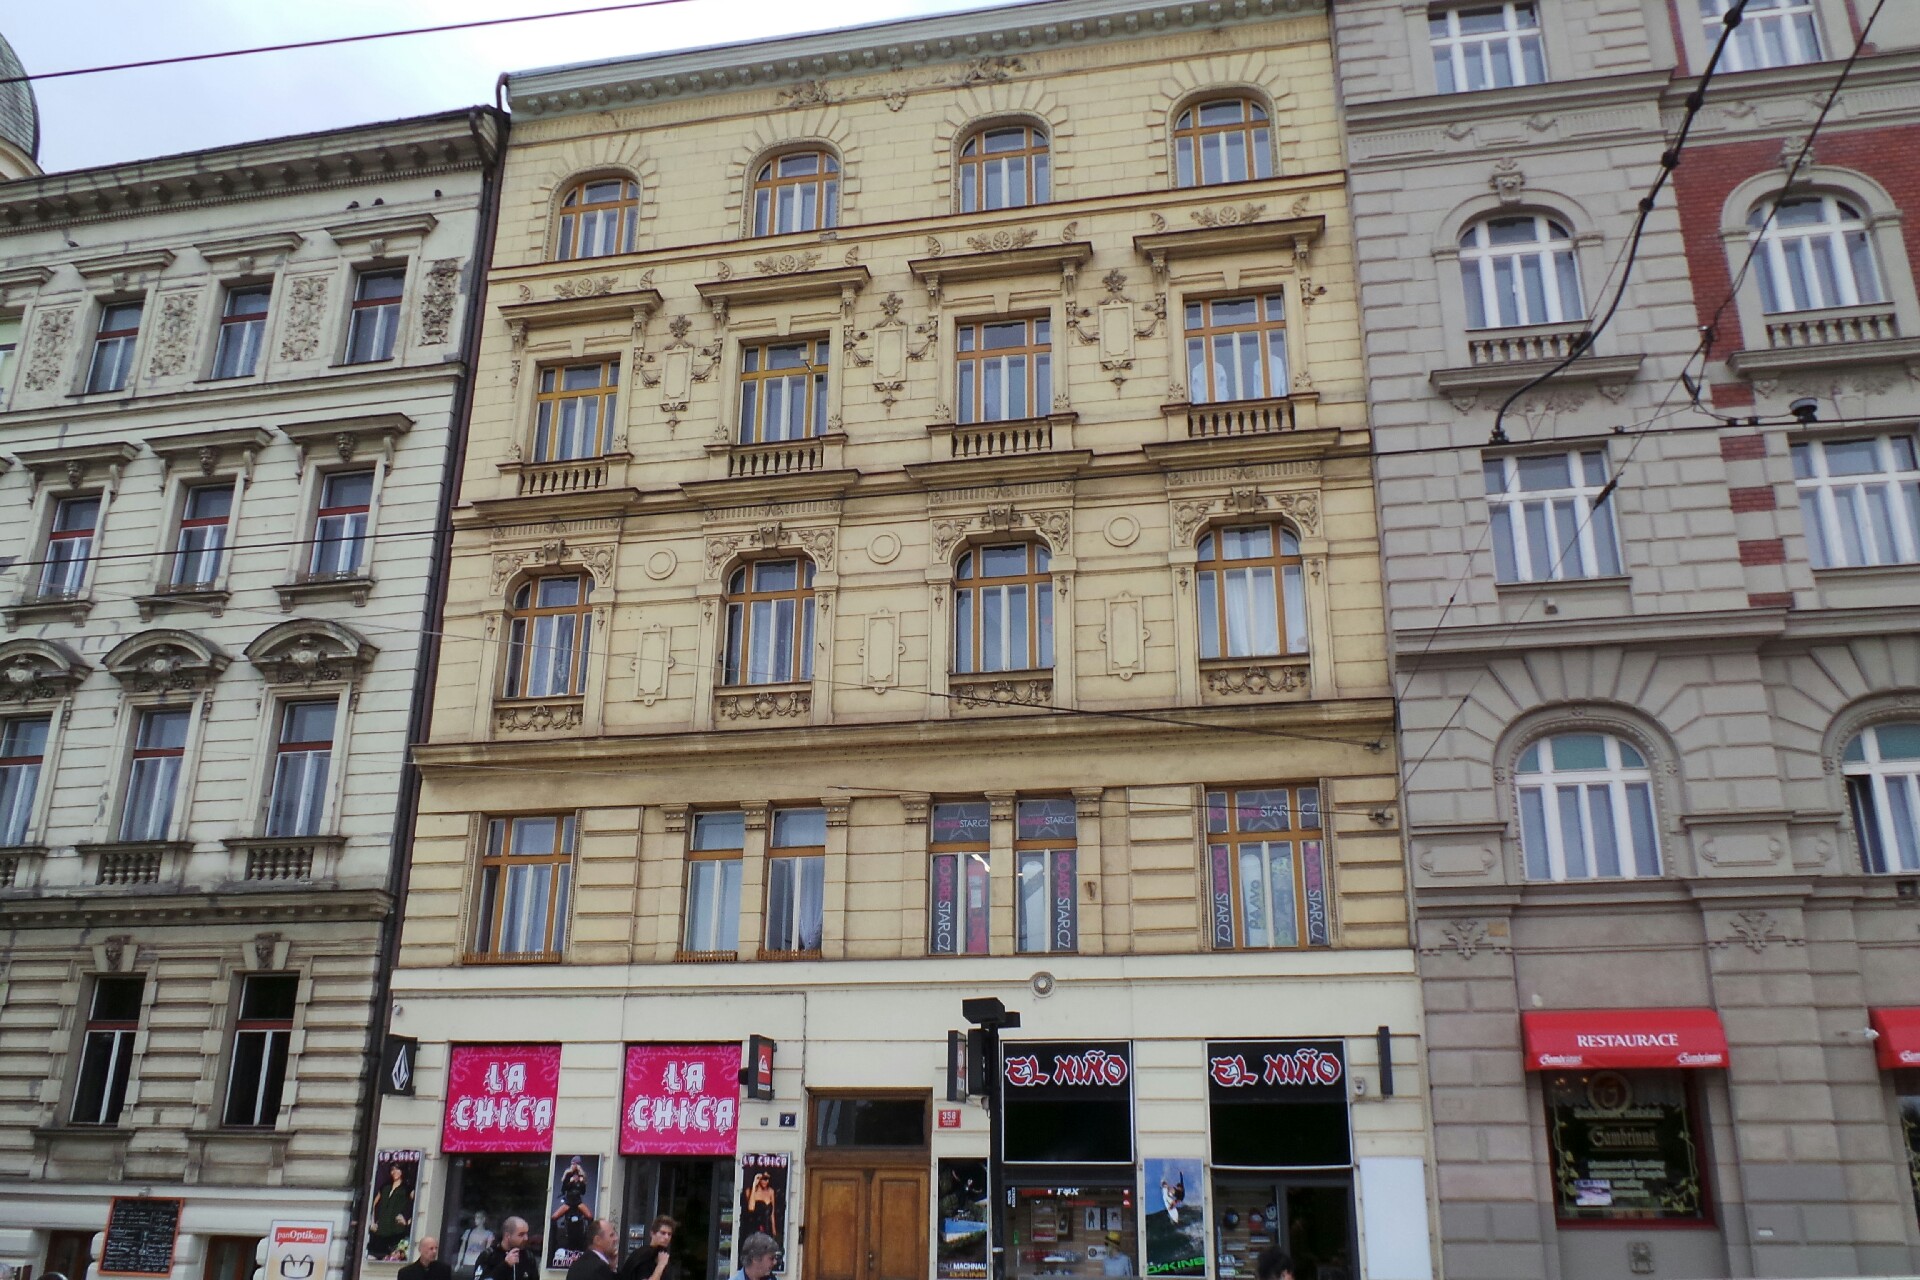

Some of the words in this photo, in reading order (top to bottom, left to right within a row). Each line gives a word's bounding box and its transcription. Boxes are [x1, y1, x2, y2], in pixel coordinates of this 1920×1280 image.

[1576, 1033, 1680, 1048] RESTAURACE
[1676, 1052, 1723, 1064] Gambrinus
[1005, 1055, 1050, 1086] EL
[1053, 1050, 1128, 1086] NIÑO
[1210, 1054, 1258, 1087] EL
[1263, 1048, 1342, 1086] NIÑO
[484, 1062, 527, 1096] LA
[662, 1061, 706, 1097] LA
[451, 1096, 553, 1134] CHICA
[628, 1095, 735, 1135] CHICA
[784, 1115, 791, 1125] 2
[379, 1152, 390, 1162] LA
[393, 1151, 420, 1162] CHICA
[743, 1155, 755, 1167] LA
[758, 1155, 787, 1168] CHICA
[1057, 1187, 1079, 1197] FOX
[277, 1230, 325, 1241] panOptikum
[1147, 1256, 1205, 1274] DAKINE
